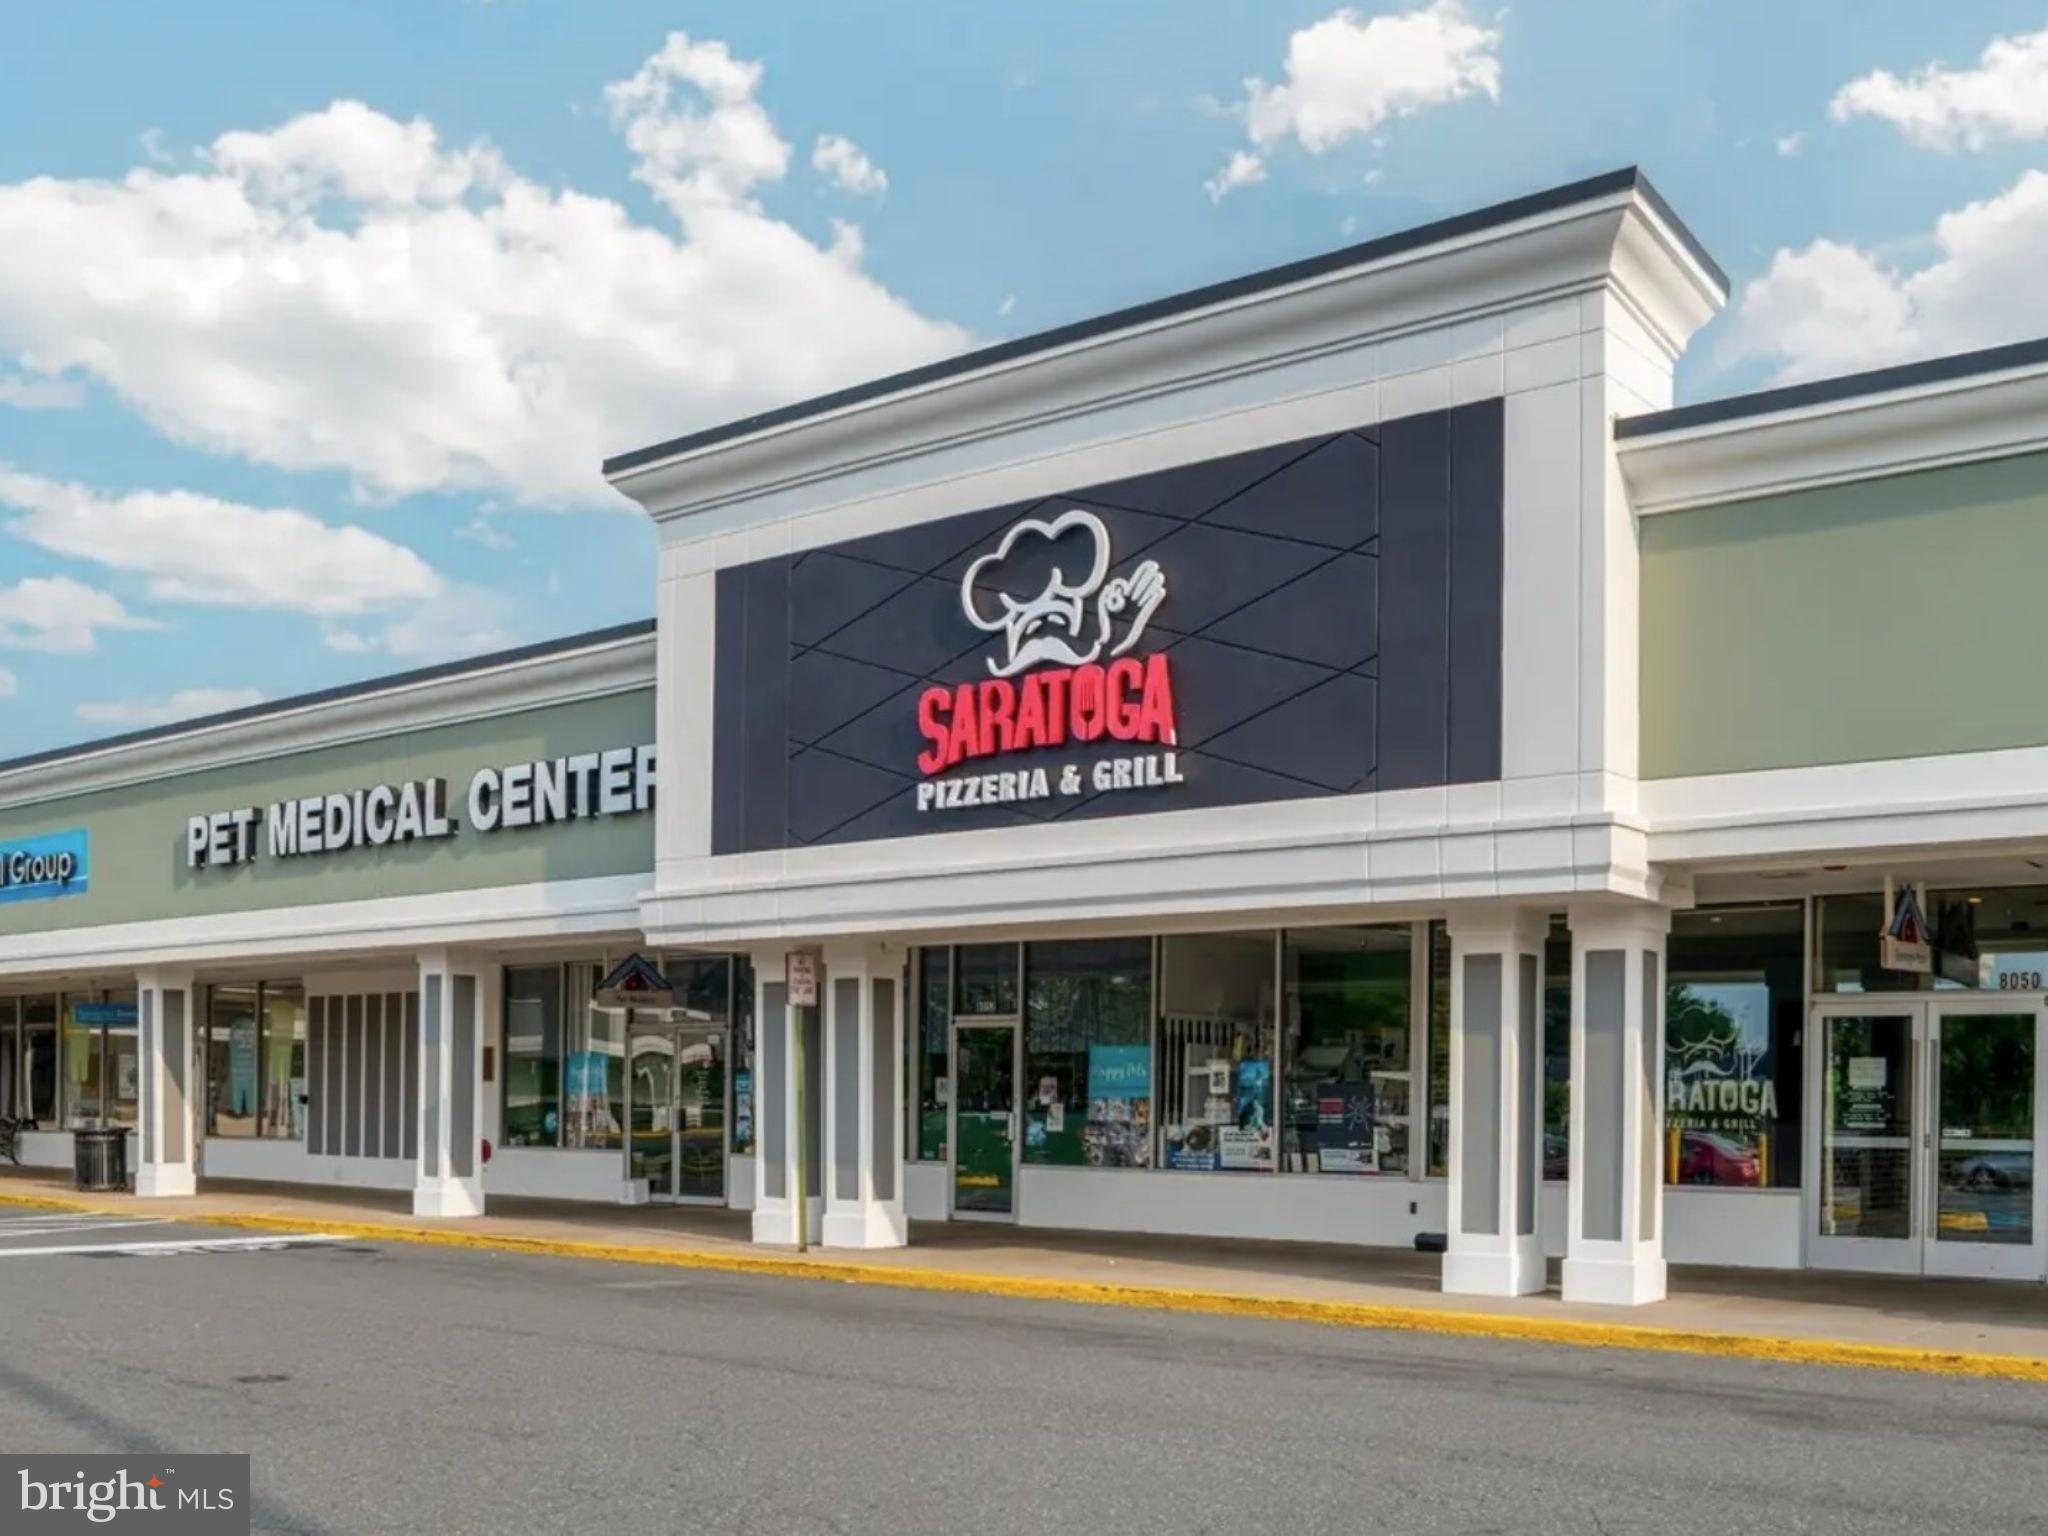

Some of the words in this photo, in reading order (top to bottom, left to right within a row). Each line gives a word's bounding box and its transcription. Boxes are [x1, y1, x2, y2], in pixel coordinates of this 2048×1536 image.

[917, 653, 1177, 775] SARATOGA
[917, 768, 1049, 811] PIZZERIA
[1059, 764, 1082, 795] &
[1092, 752, 1184, 790] GRILL
[187, 807, 256, 867] PET
[269, 778, 450, 857] MEDICAL
[10, 851, 71, 886] Group
[2000, 972, 2040, 989] 8050
[1667, 1077, 1778, 1118] RATOGA
